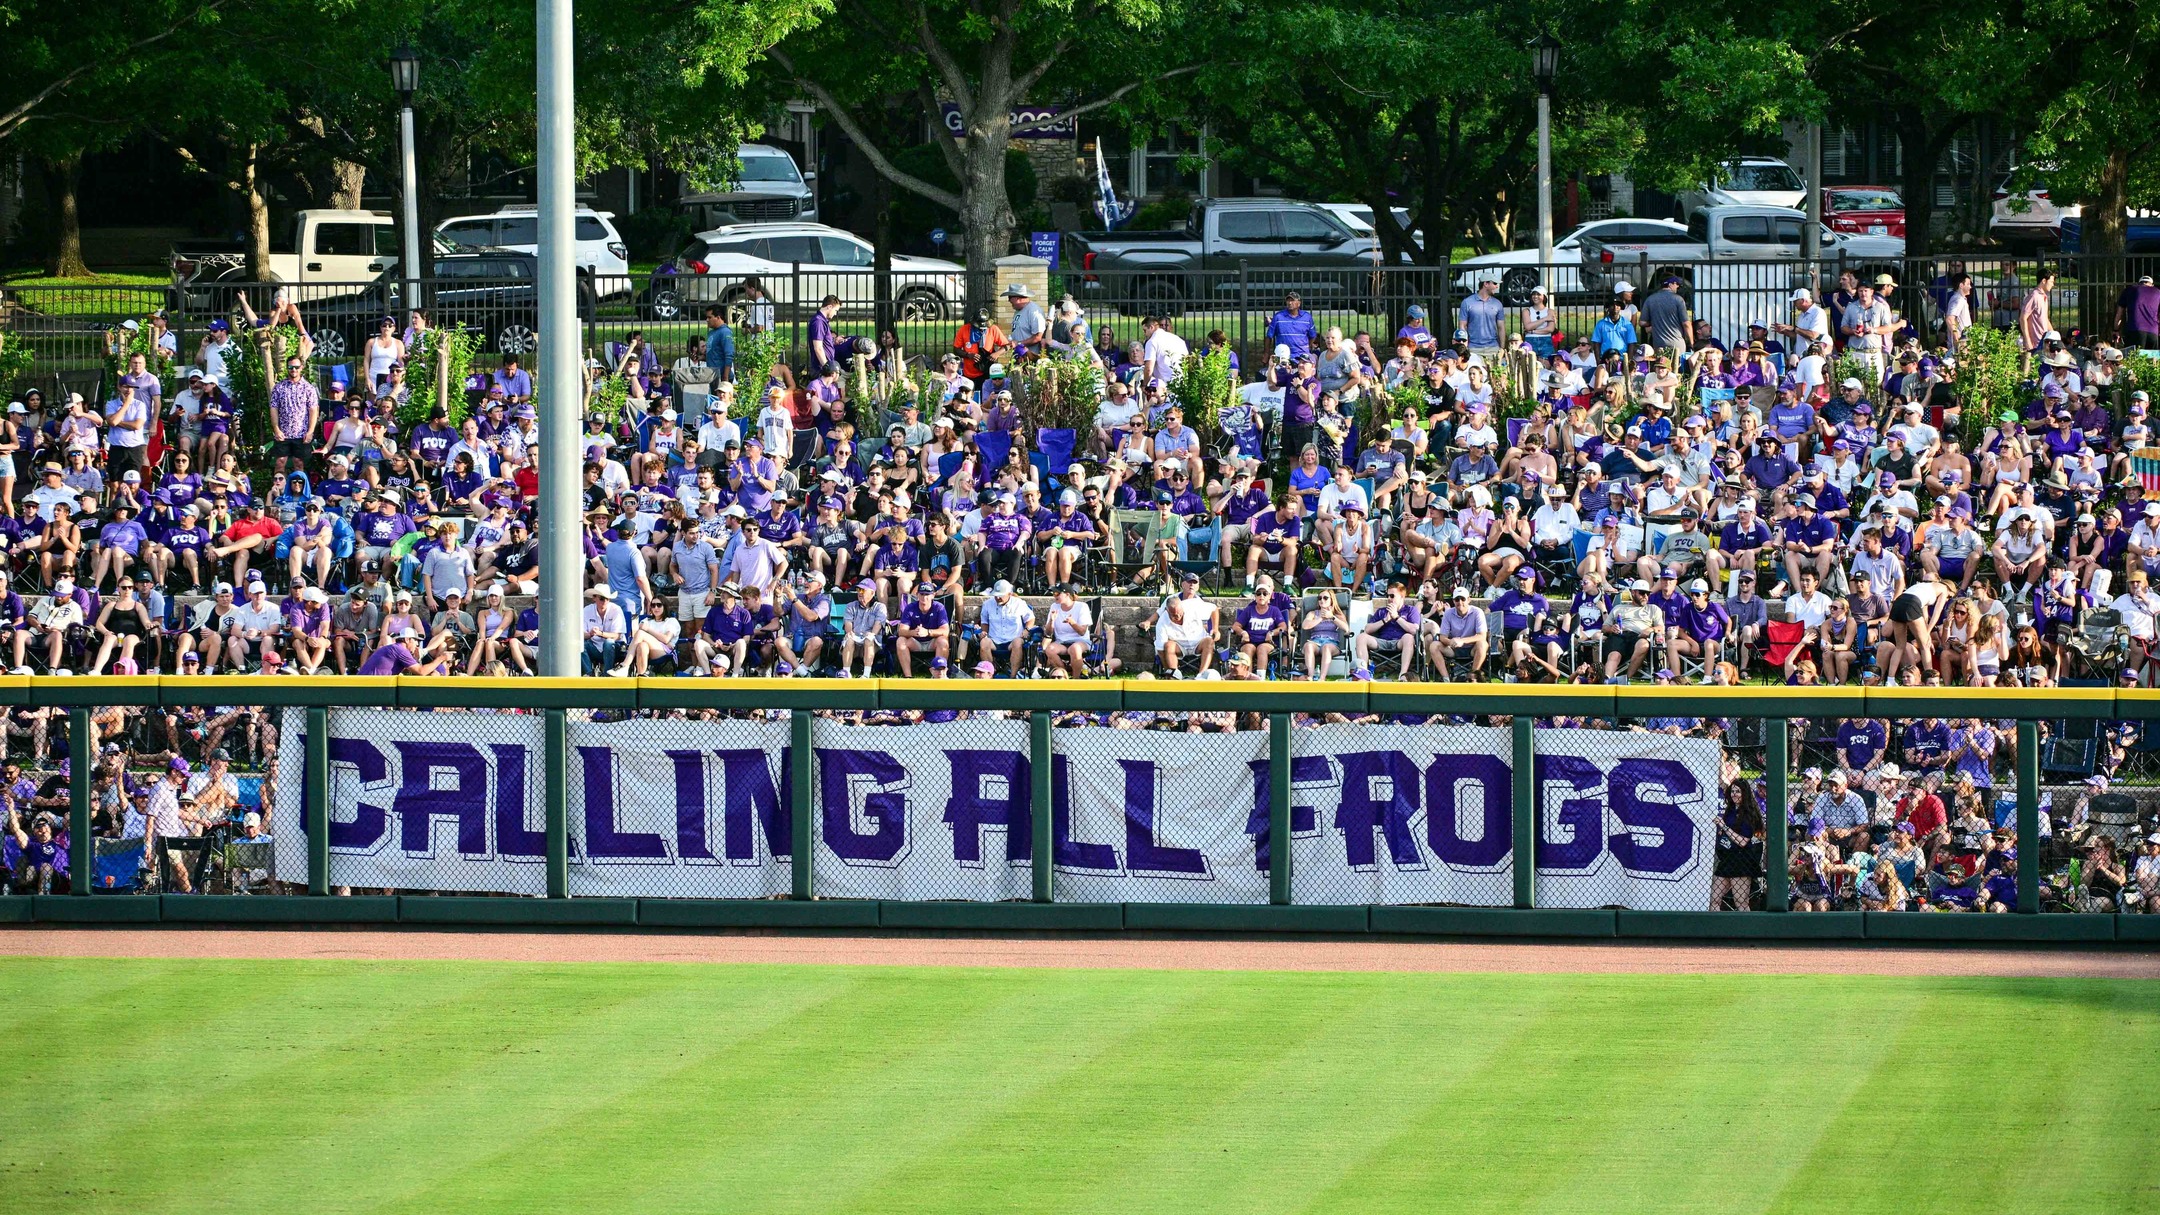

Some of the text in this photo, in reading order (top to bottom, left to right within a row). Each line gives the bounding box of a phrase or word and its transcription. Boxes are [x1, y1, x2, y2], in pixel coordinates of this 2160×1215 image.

[1845, 431, 1867, 441] TCU
[422, 437, 447, 449] TCU
[386, 475, 411, 487] TCU
[992, 518, 1019, 527] TCU
[171, 533, 200, 546] TCU
[481, 526, 503, 543] TCU
[1674, 538, 1695, 548] TCU
[1249, 617, 1275, 631] TCU
[1850, 735, 1869, 745] TCU
[297, 734, 1703, 882] CALLING ALL FROGS
